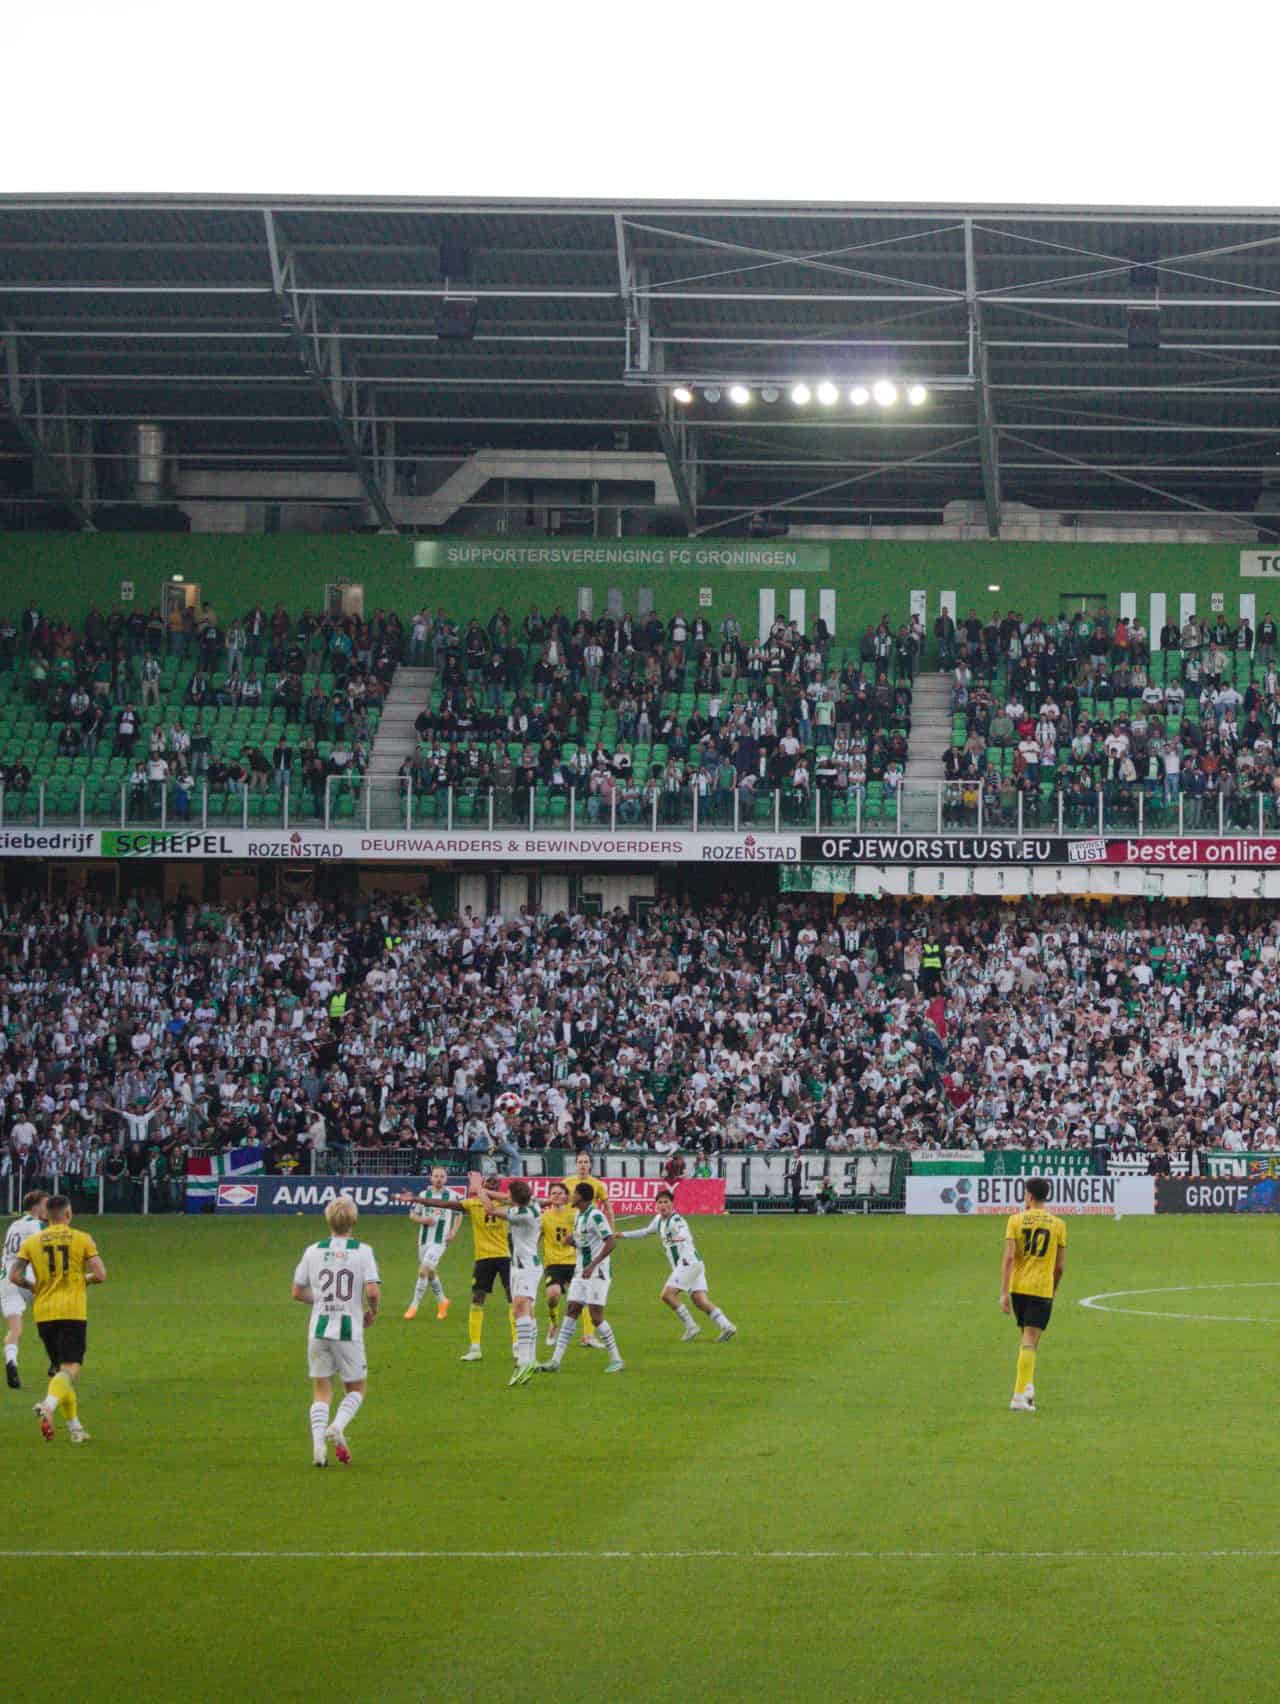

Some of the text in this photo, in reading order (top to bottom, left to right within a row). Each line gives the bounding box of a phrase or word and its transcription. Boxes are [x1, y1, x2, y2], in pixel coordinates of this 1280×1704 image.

[447, 547, 797, 566] SUPPORTERSVERENIGING FC GRONINGEN
[116, 835, 233, 854] SCHEPEL
[247, 842, 344, 857] ROZENSTAD
[360, 838, 683, 854] DEURWAARDERS & BEWINDVOERDERS
[702, 845, 797, 860] ROZENSTAD
[821, 838, 1051, 861] OFJEWORSTLUST.EU
[1070, 847, 1105, 862] LUST
[1126, 839, 1278, 863] bestel online
[977, 1178, 1115, 1203] BETODINGEN
[1022, 1228, 1050, 1257] 10
[43, 1245, 70, 1274] 11
[319, 1268, 354, 1302] 20
